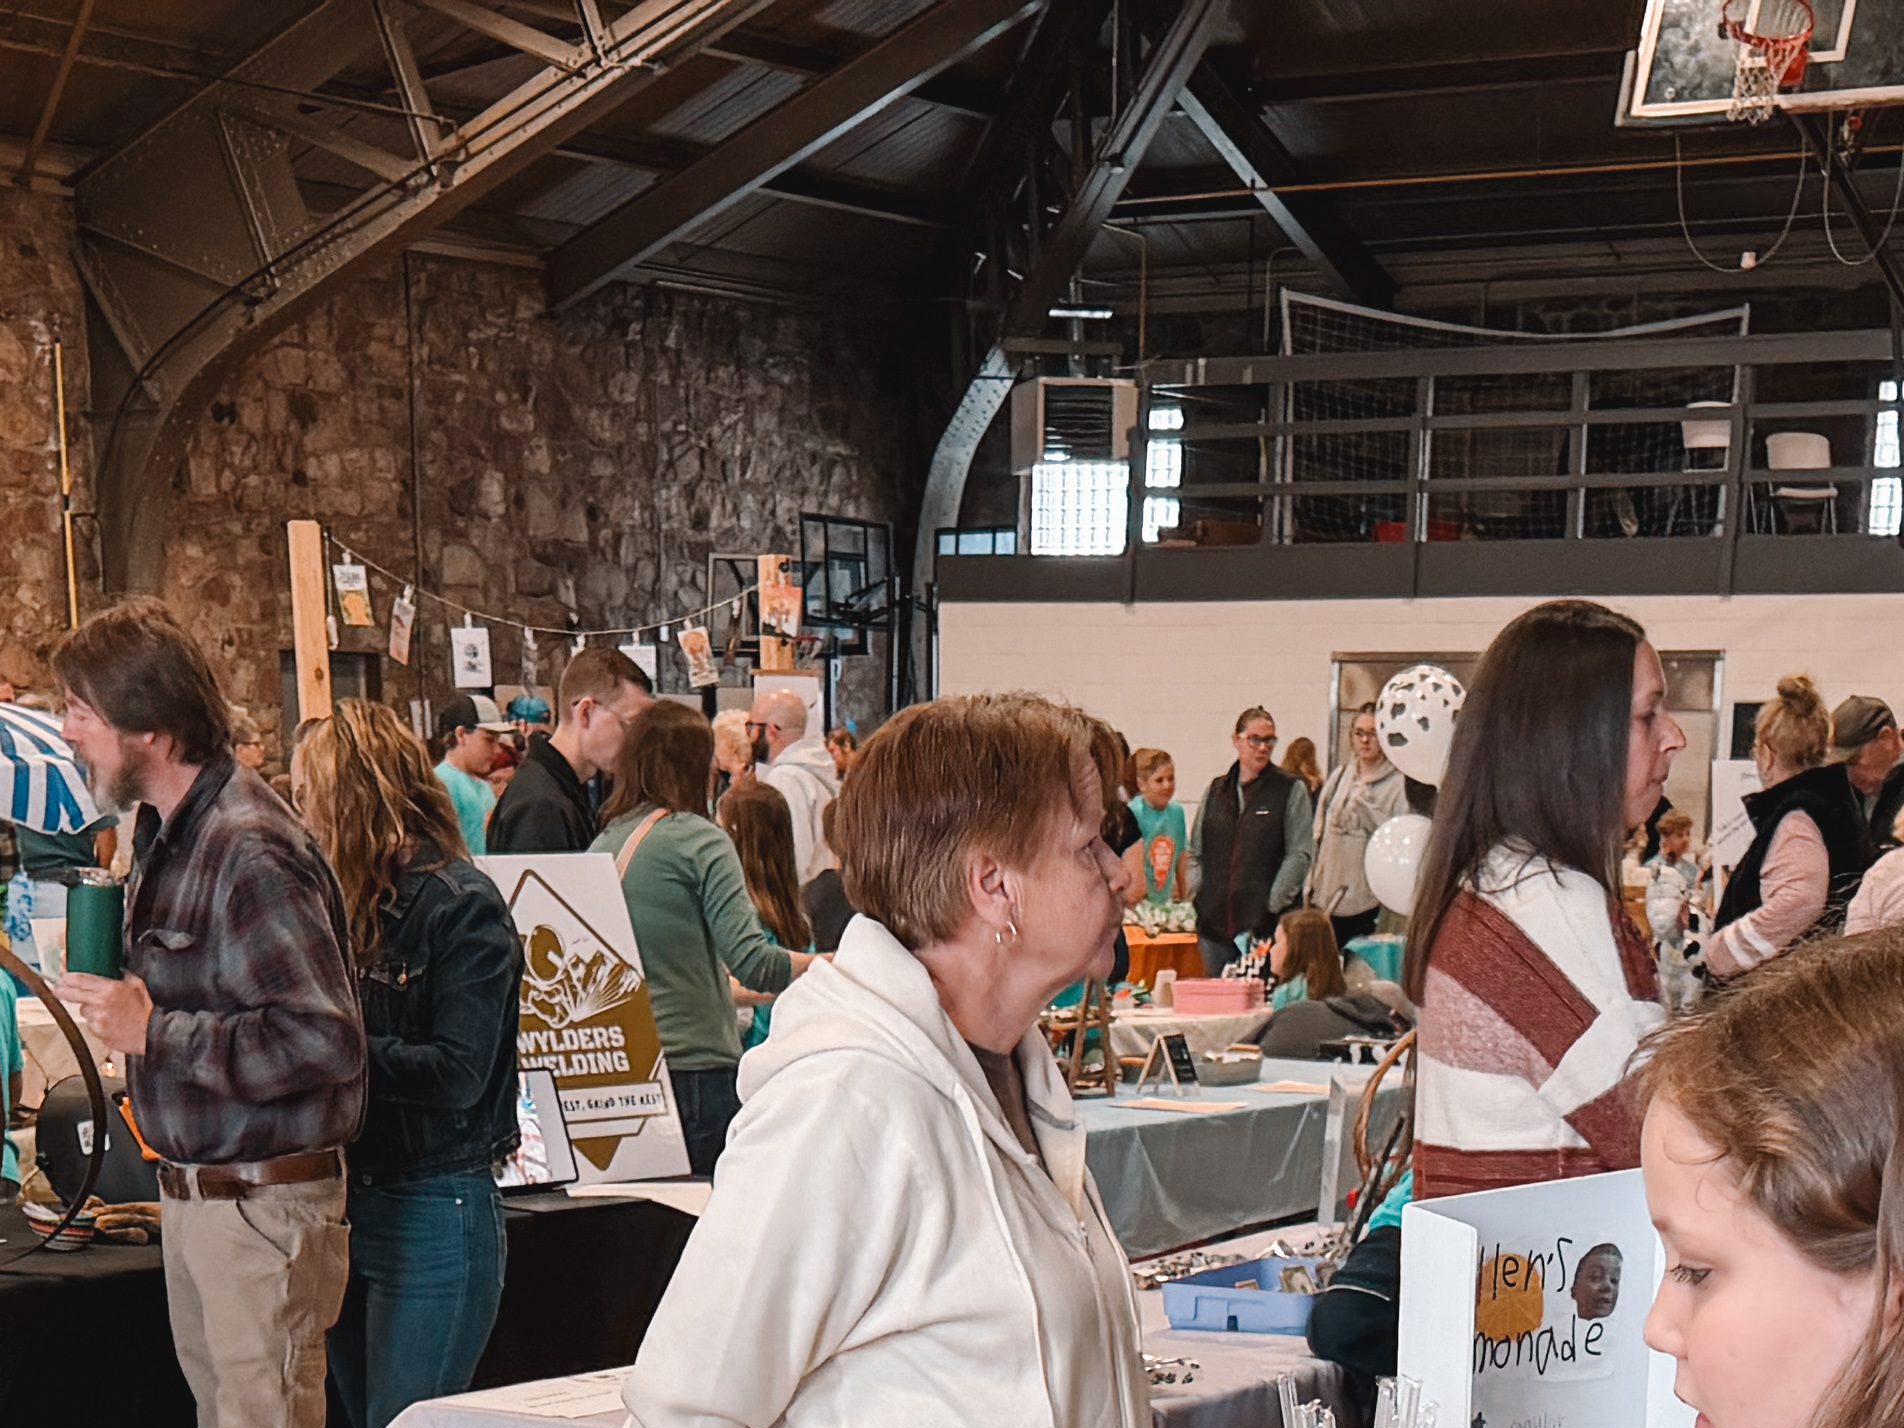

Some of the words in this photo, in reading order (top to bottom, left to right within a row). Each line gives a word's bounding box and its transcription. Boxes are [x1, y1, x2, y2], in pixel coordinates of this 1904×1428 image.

[517, 1026, 626, 1054] WYLDERS
[520, 1050, 631, 1078] WELDING
[618, 1094, 637, 1107] THE
